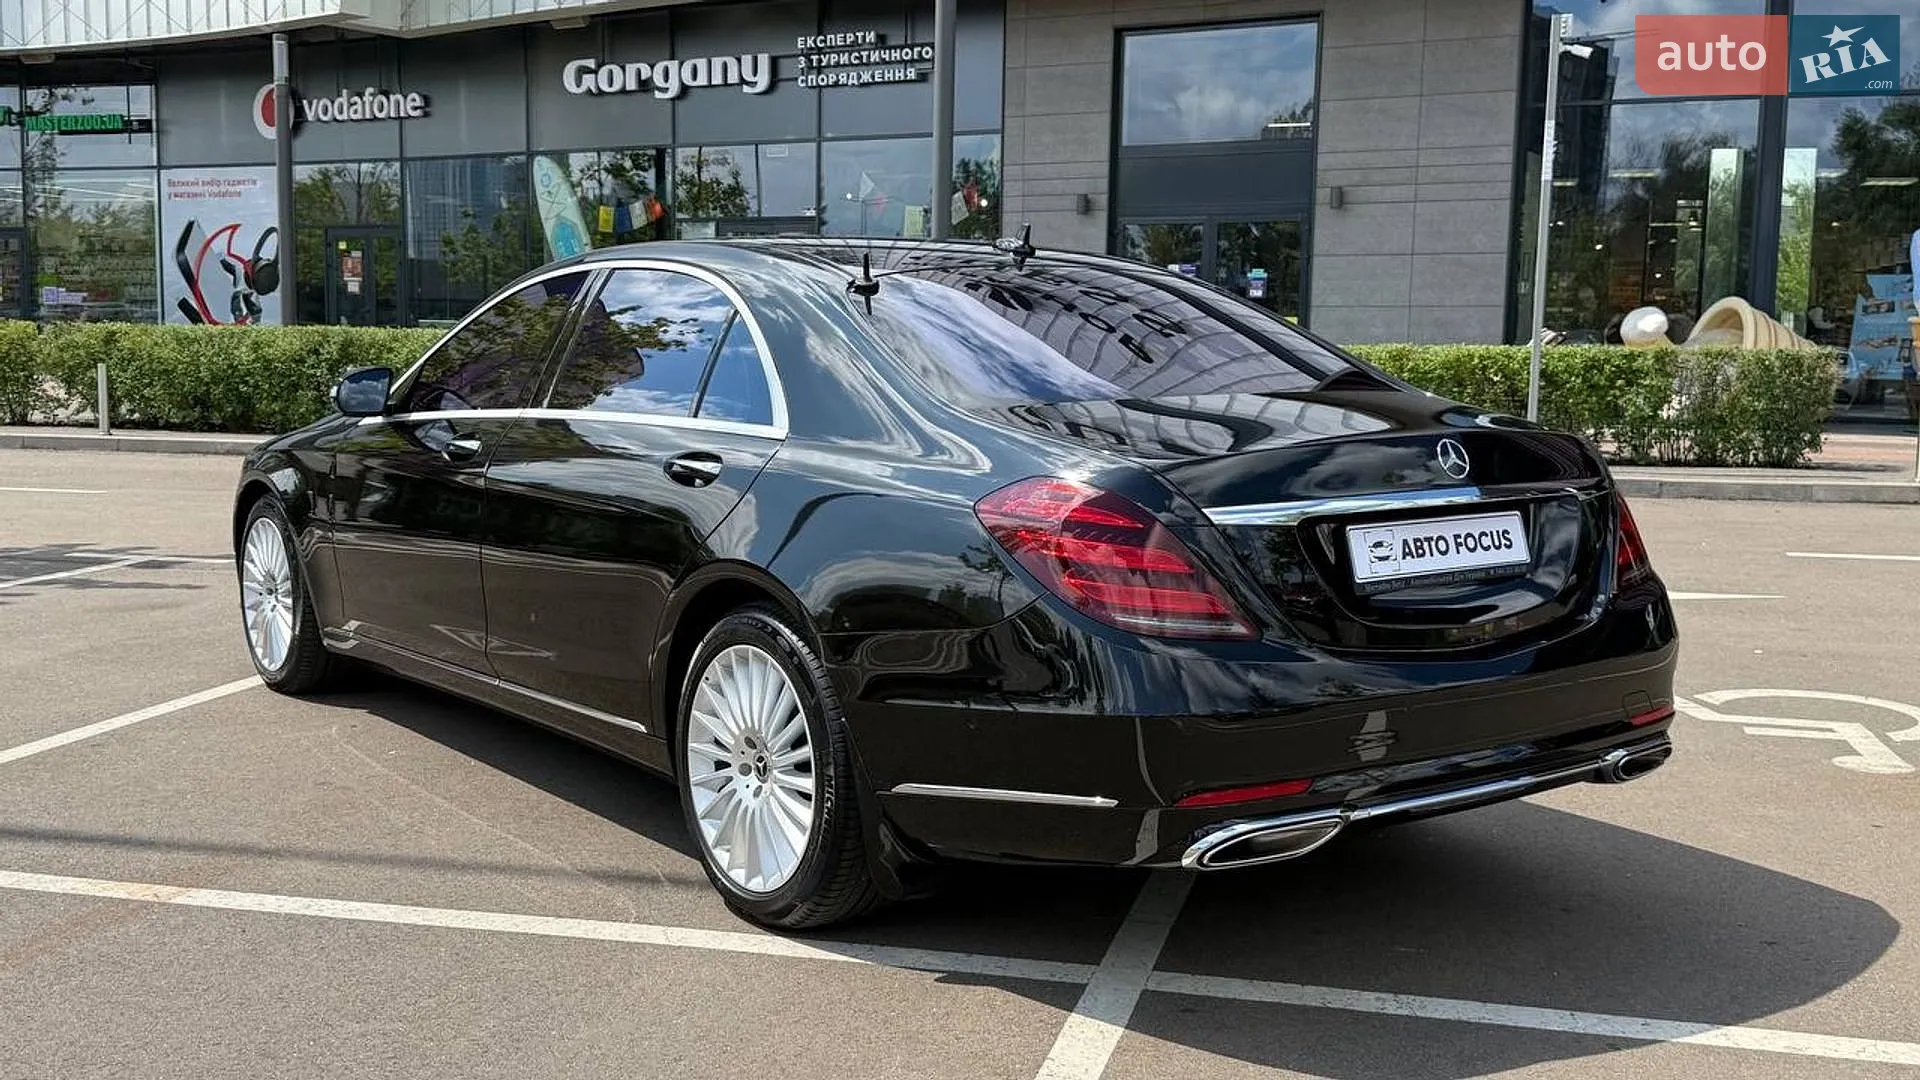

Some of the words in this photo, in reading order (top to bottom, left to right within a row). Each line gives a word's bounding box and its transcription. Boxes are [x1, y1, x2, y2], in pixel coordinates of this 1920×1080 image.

[797, 31, 875, 49] ЕКСПЕРТИ
[810, 46, 933, 67] ТУРИСТИЧНОГО
[562, 53, 770, 99] Gorgany
[797, 68, 917, 87] СПОРЯДЖЕННЯ
[302, 87, 425, 121] vodafone
[25, 114, 122, 131] MASTERZOO.UA
[1401, 535, 1450, 560] АВТО
[1453, 529, 1514, 555] FOCUS
